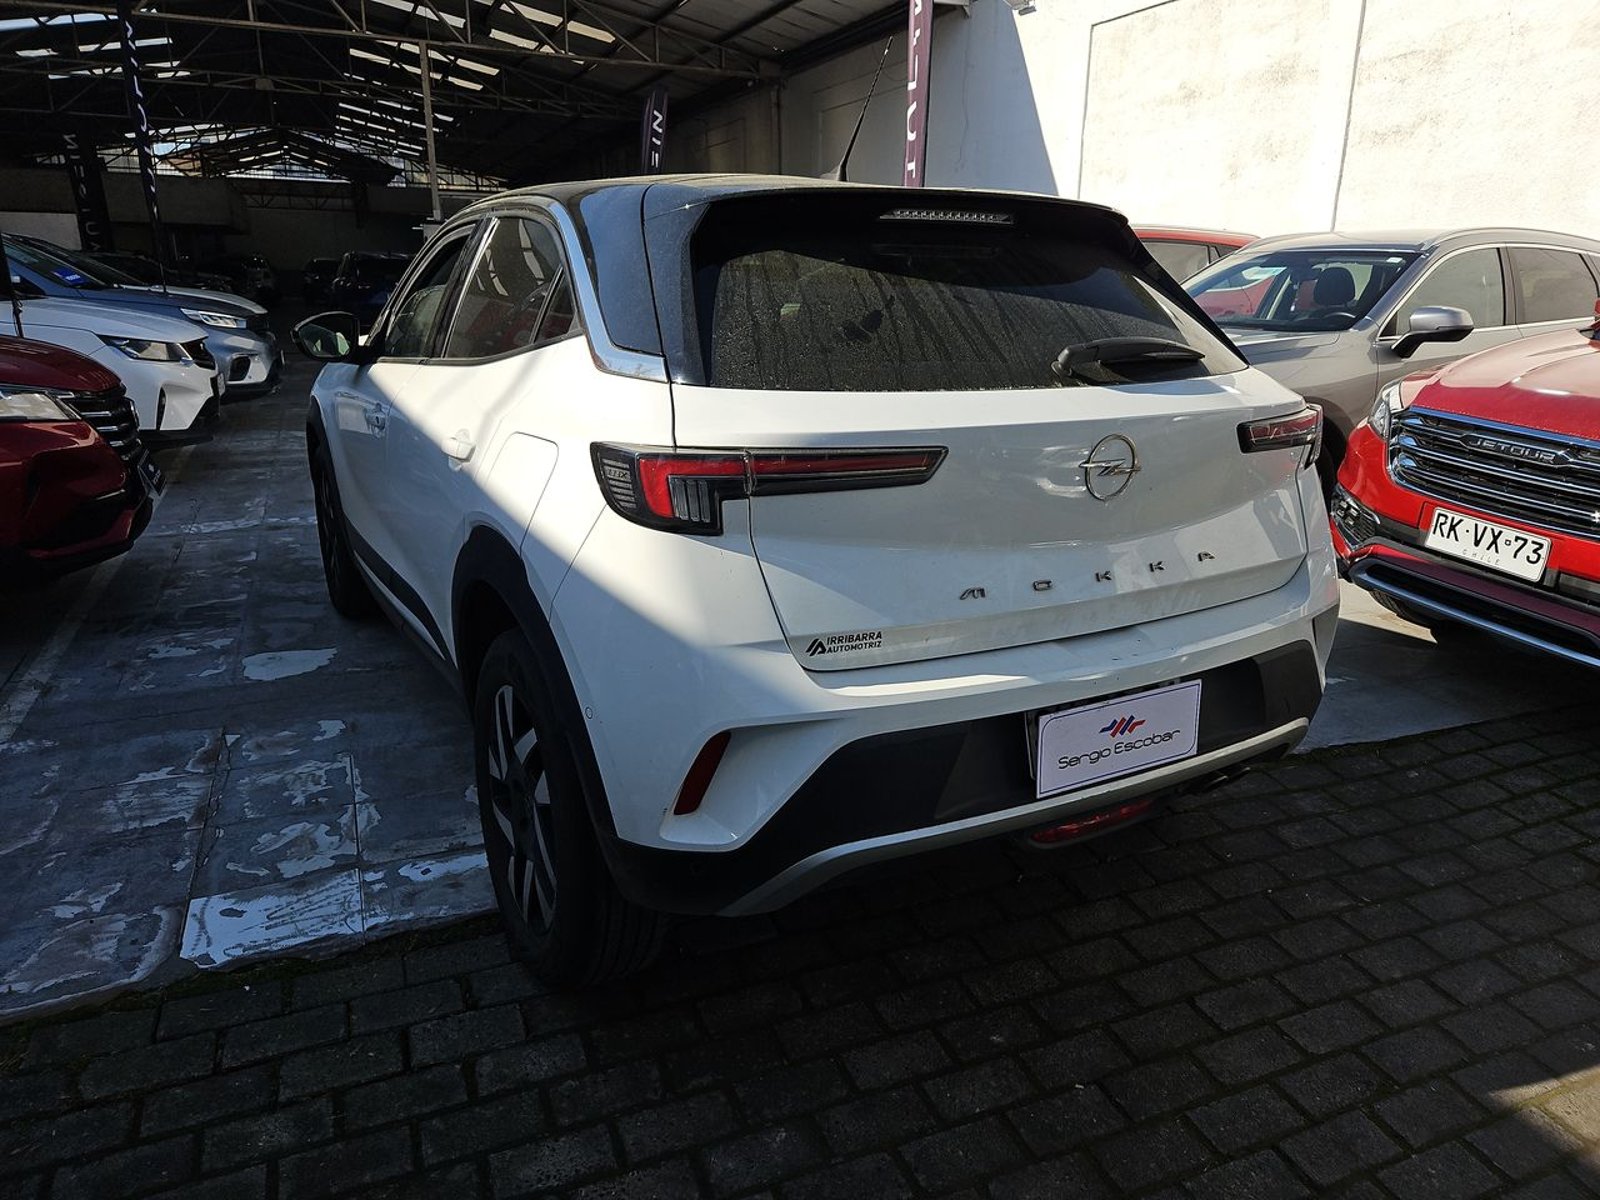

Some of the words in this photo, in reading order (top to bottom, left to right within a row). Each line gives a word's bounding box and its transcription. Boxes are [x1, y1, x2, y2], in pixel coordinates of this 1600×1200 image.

[1468, 438, 1556, 464] JETOUR
[959, 550, 1216, 601] MOKKA
[827, 631, 882, 646] IRRIBARRA
[827, 640, 882, 655] AUTOMOTRIZ
[1058, 748, 1112, 770] Sergio
[1114, 729, 1181, 755] Escobar
